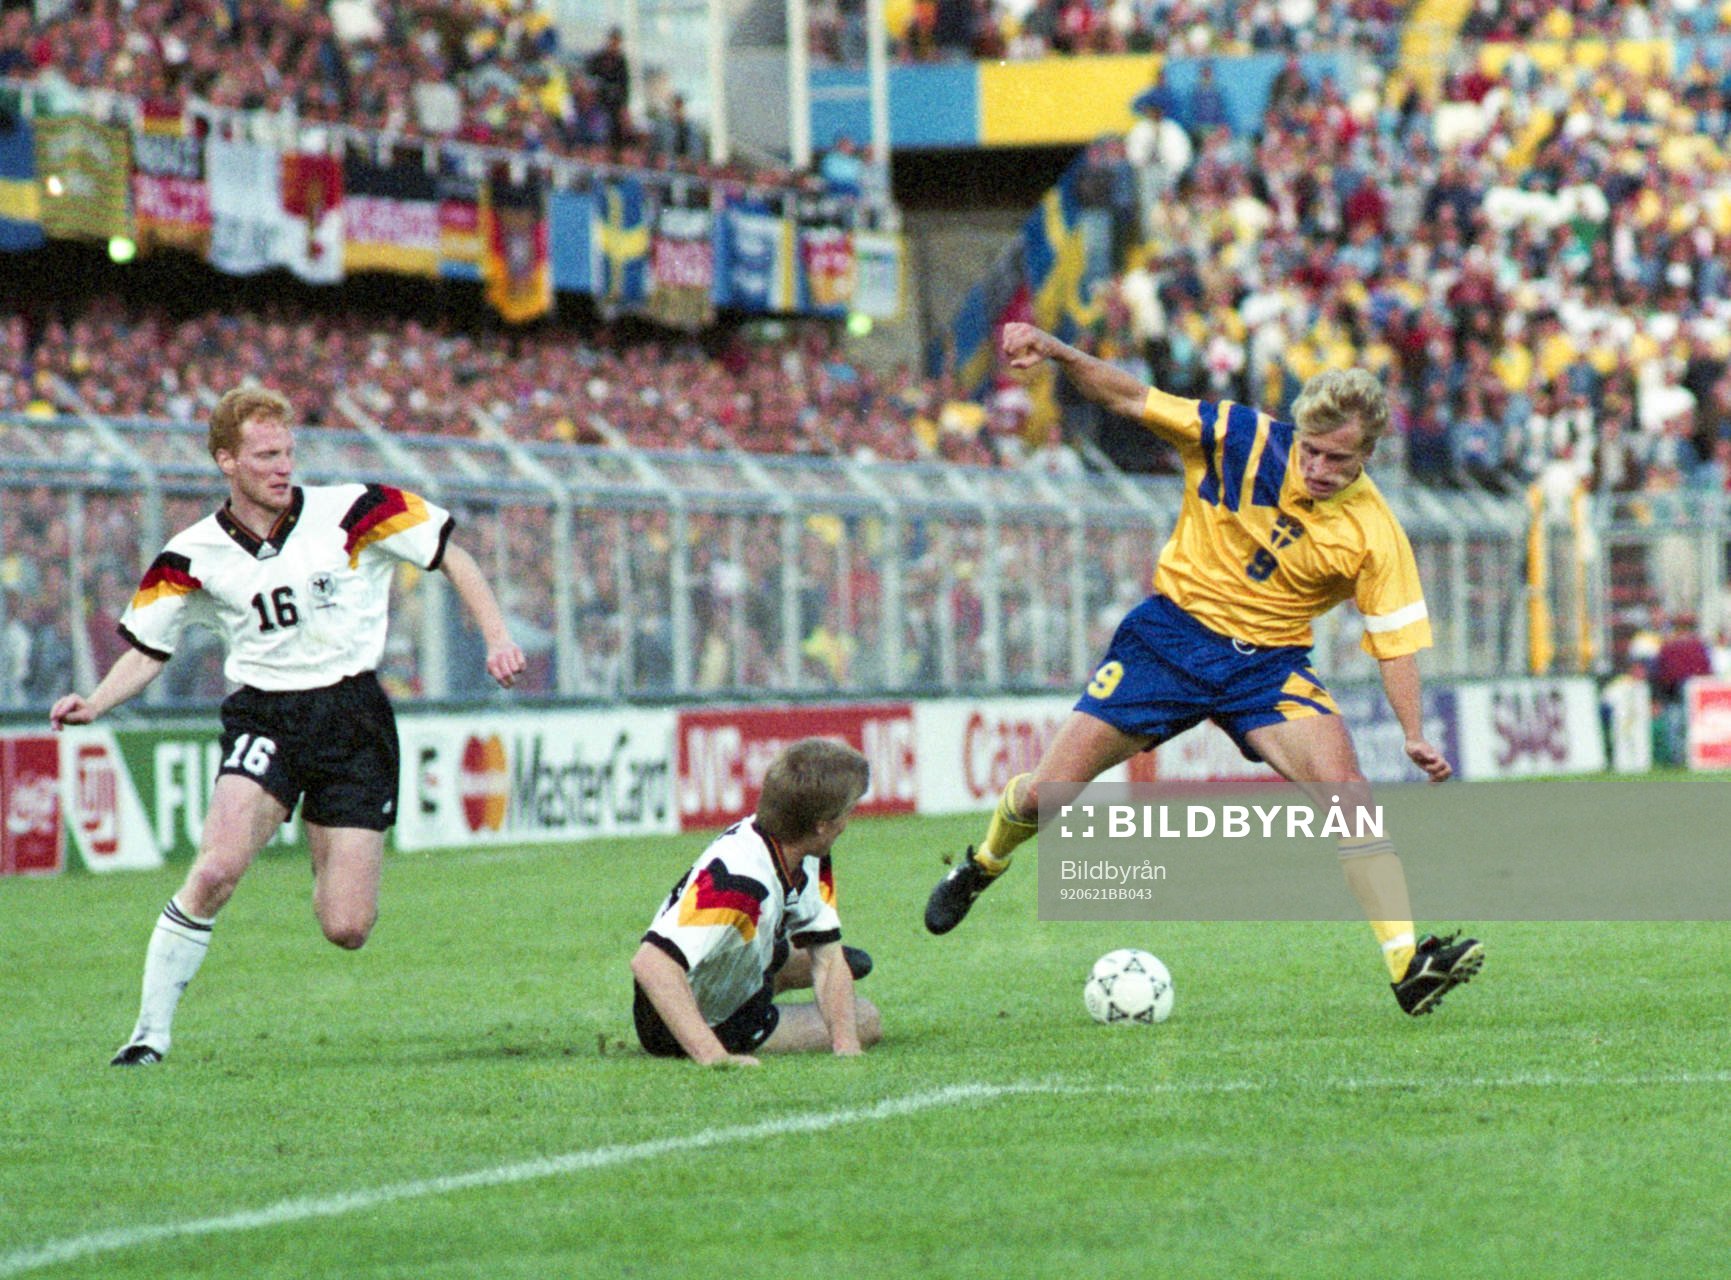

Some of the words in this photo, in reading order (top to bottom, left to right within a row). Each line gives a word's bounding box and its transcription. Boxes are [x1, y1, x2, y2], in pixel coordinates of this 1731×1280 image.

[1246, 547, 1277, 582] 9
[251, 585, 299, 633] 16
[1086, 660, 1125, 700] 9
[223, 733, 278, 777] 16
